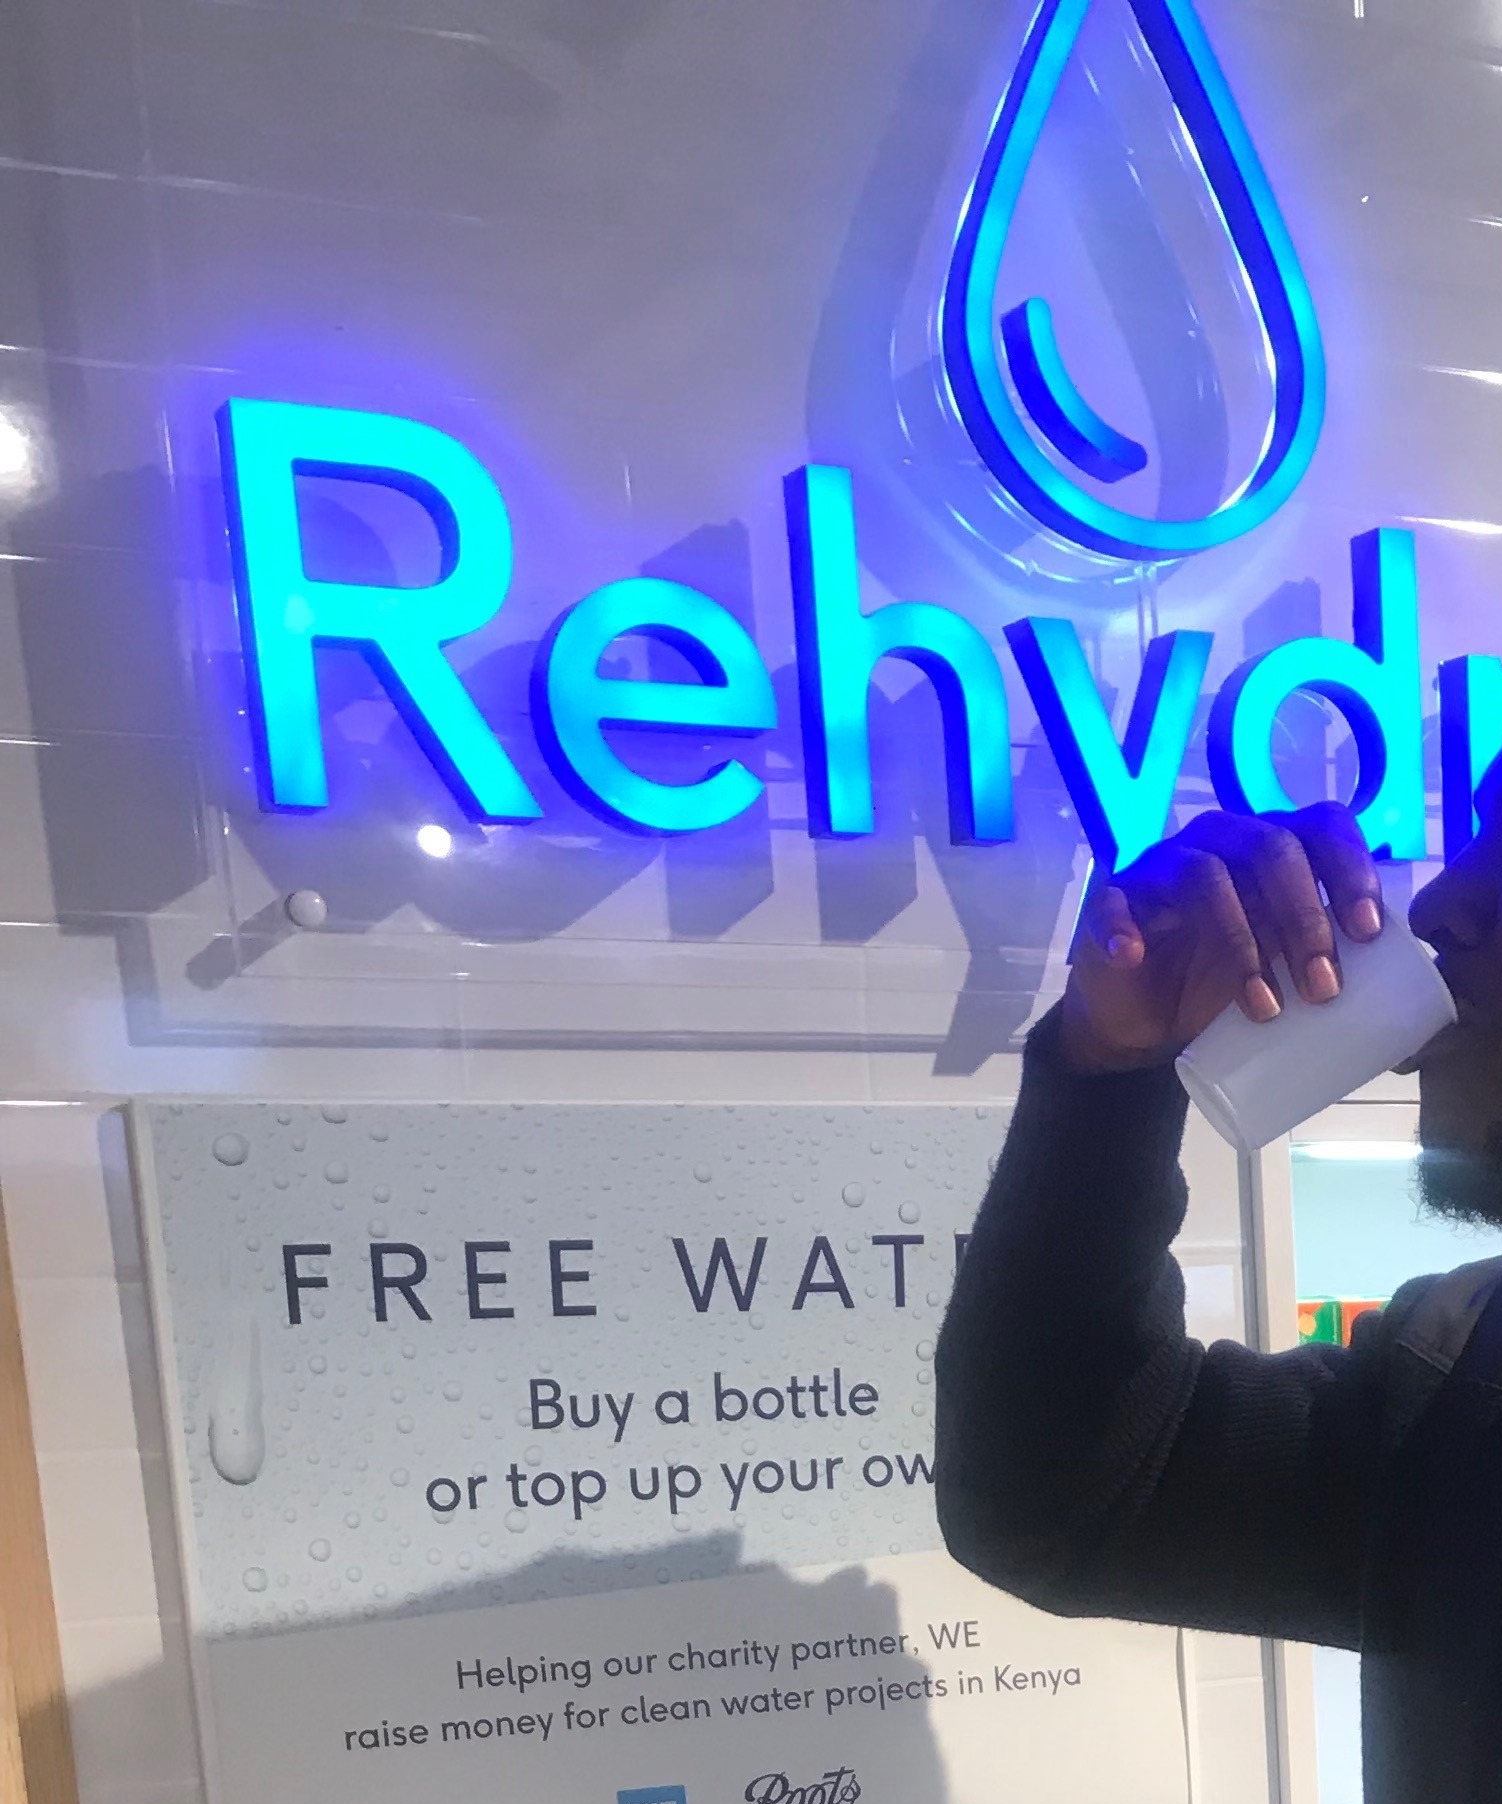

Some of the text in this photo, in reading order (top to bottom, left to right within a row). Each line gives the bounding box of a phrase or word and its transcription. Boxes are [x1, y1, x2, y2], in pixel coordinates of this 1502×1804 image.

[282, 1239, 597, 1325] FREE
[529, 1367, 879, 1443] Buy a bottle
[426, 1474, 488, 1512] or
[506, 1463, 607, 1520] top
[629, 1464, 702, 1515] up
[720, 1456, 844, 1512] your
[456, 1620, 981, 1693] Helping our charity partner, WE
[345, 1664, 1082, 1751] raise money for clean water projects in Kenya
